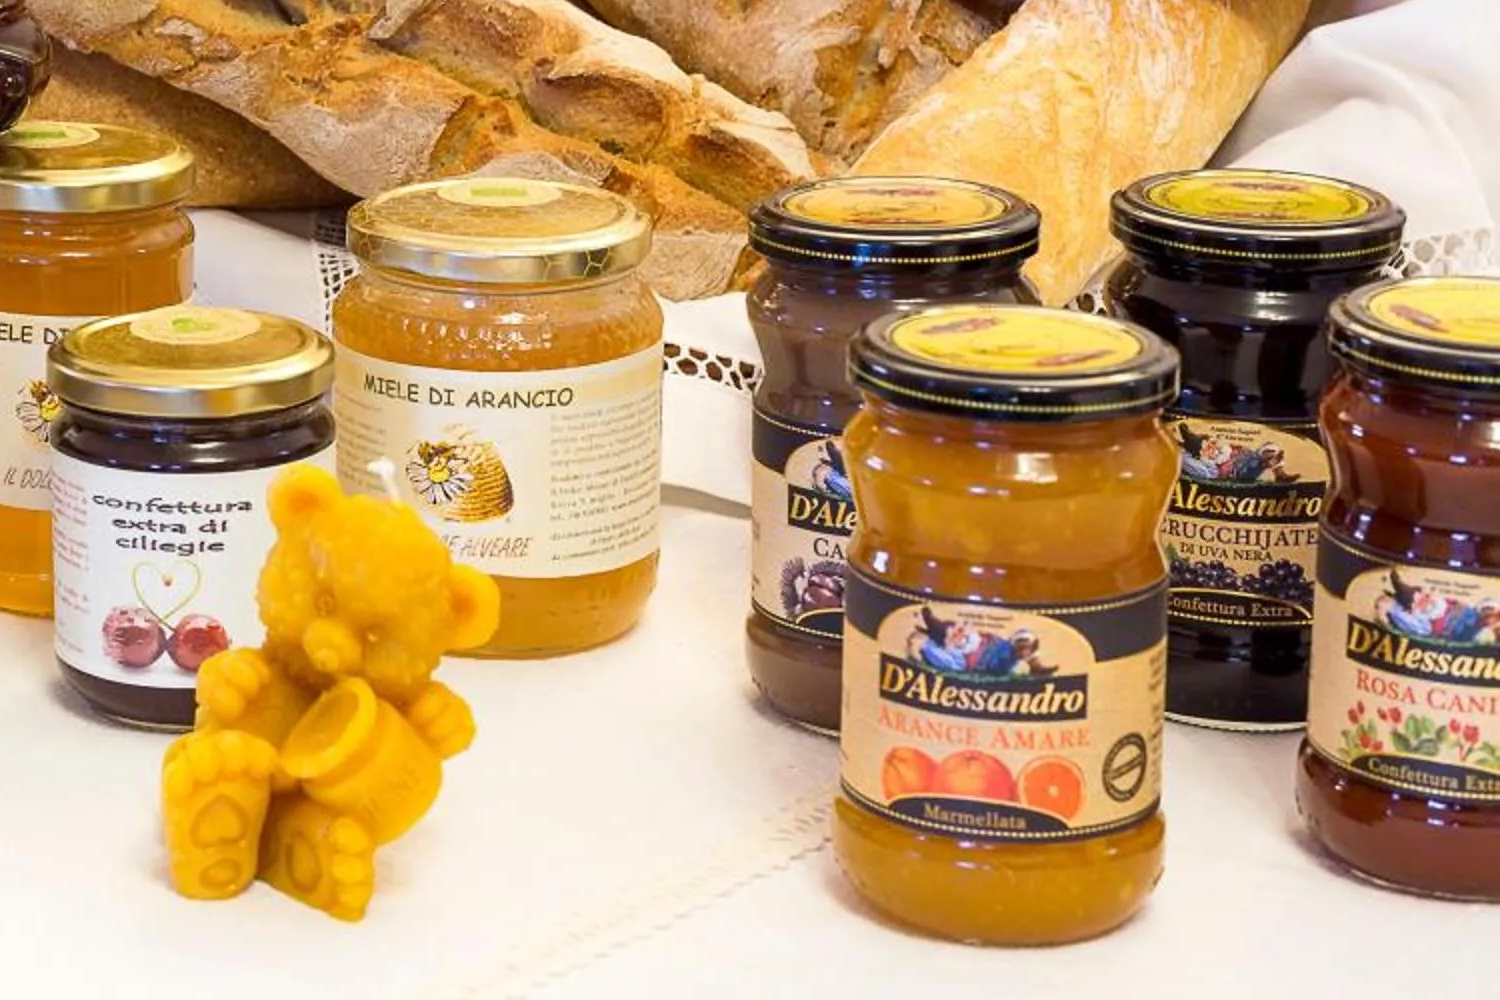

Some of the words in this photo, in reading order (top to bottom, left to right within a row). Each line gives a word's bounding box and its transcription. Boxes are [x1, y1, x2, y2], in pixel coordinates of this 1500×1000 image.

[363, 373, 419, 403] MIELE
[429, 387, 455, 407] DI
[466, 387, 574, 409] ARANCIO
[93, 494, 253, 515] confettura
[112, 518, 187, 534] extra
[199, 519, 228, 534] di
[116, 536, 225, 557] ciliegie
[1200, 543, 1229, 559] UVA
[1233, 546, 1273, 562] NERA
[1251, 603, 1293, 618] Extra
[881, 662, 1084, 715] D'Alessandro
[1356, 670, 1416, 704] ROSA
[878, 705, 980, 746] ARANCE
[990, 726, 1091, 750] AMARE
[1367, 759, 1458, 789] Confettura
[924, 804, 1027, 830] Marmellata
